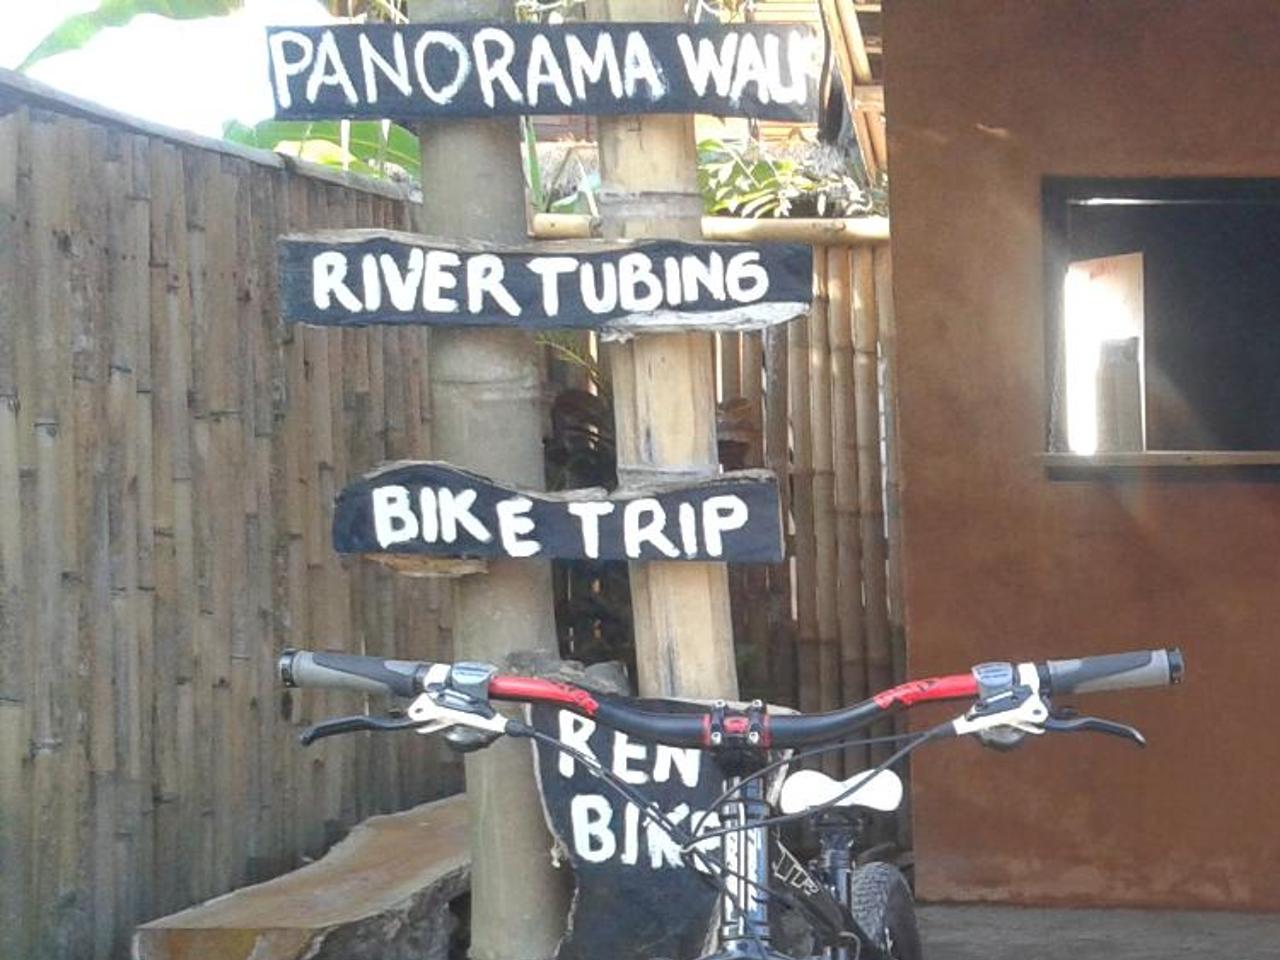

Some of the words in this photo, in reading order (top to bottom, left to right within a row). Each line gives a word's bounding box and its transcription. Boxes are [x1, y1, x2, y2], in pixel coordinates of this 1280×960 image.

[268, 27, 668, 109] PANORAMA
[311, 248, 523, 316] RIVER
[525, 250, 770, 316] TUBING
[371, 484, 542, 558] BIKE
[567, 494, 750, 560] TRIP
